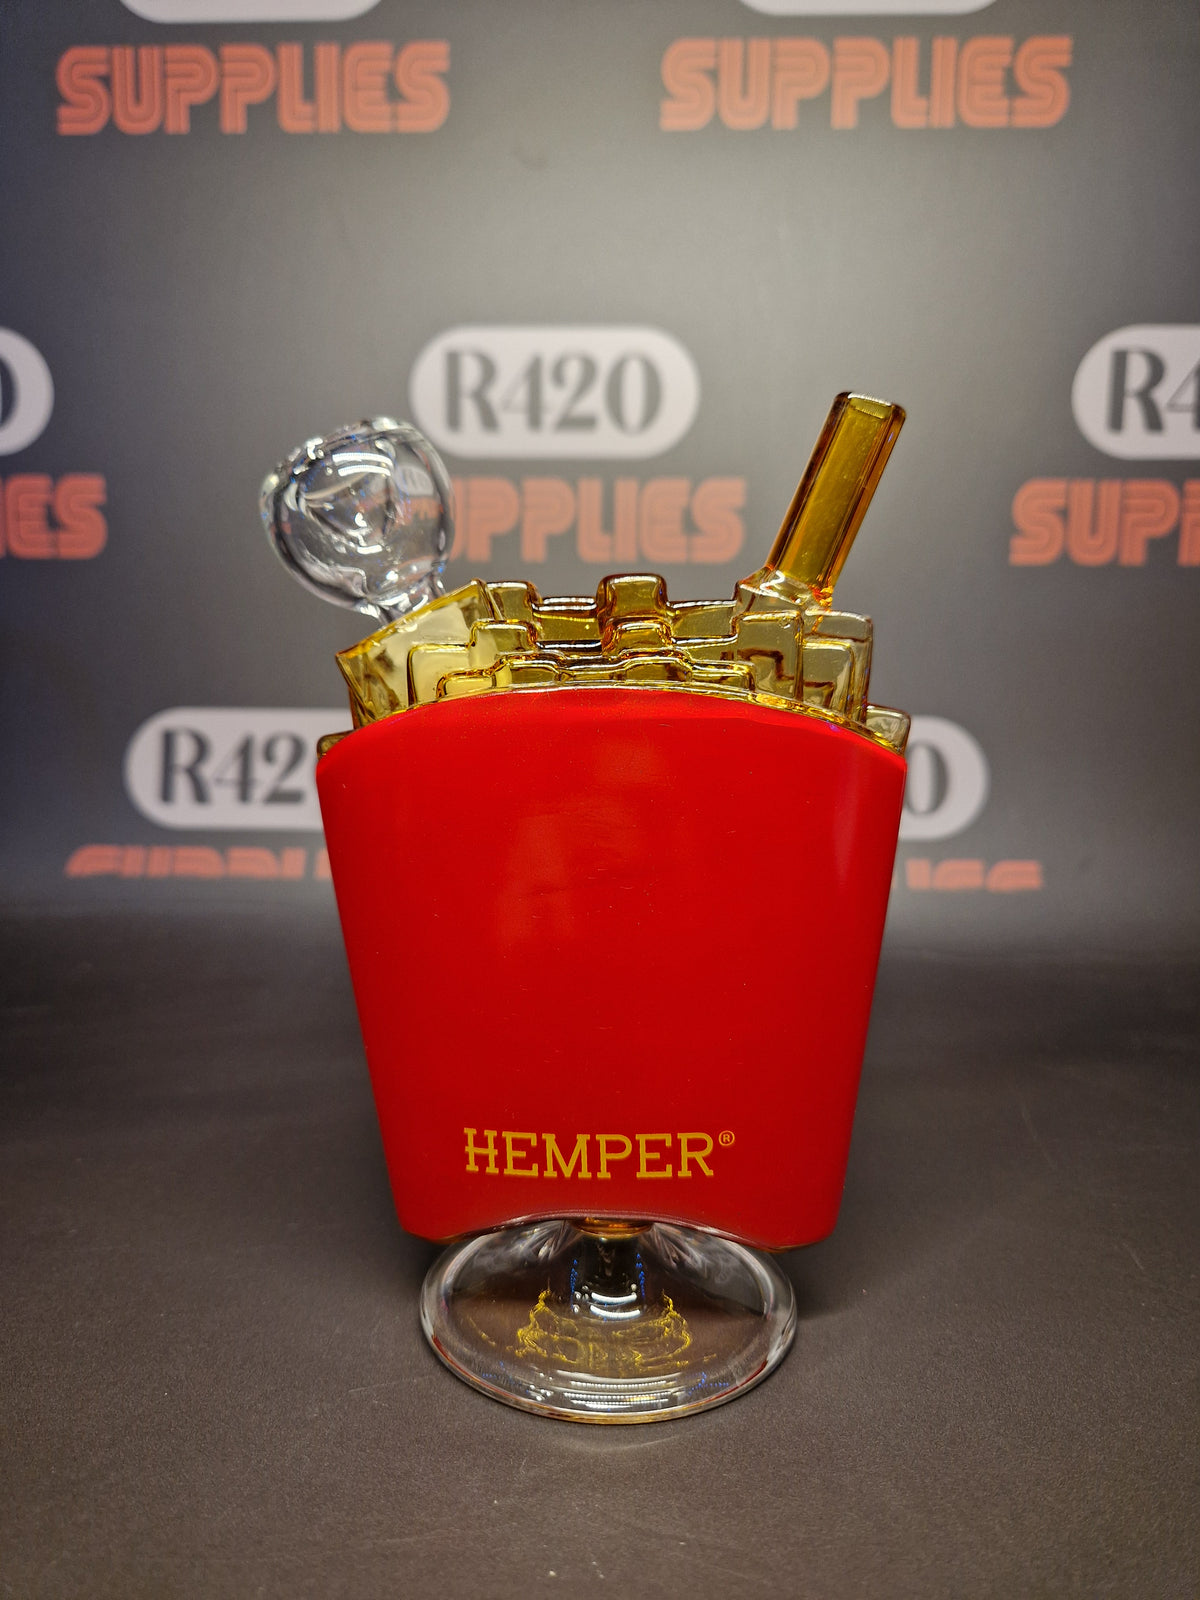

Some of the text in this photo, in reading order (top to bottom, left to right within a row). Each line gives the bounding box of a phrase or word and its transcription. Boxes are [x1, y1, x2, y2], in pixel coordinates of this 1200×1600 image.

[56, 40, 450, 135] SUPPLIES
[660, 36, 1072, 131] SUPPLIES
[445, 350, 663, 436] R420
[0, 473, 108, 560] ES
[450, 476, 747, 564] PPLIES
[160, 727, 308, 805] R42
